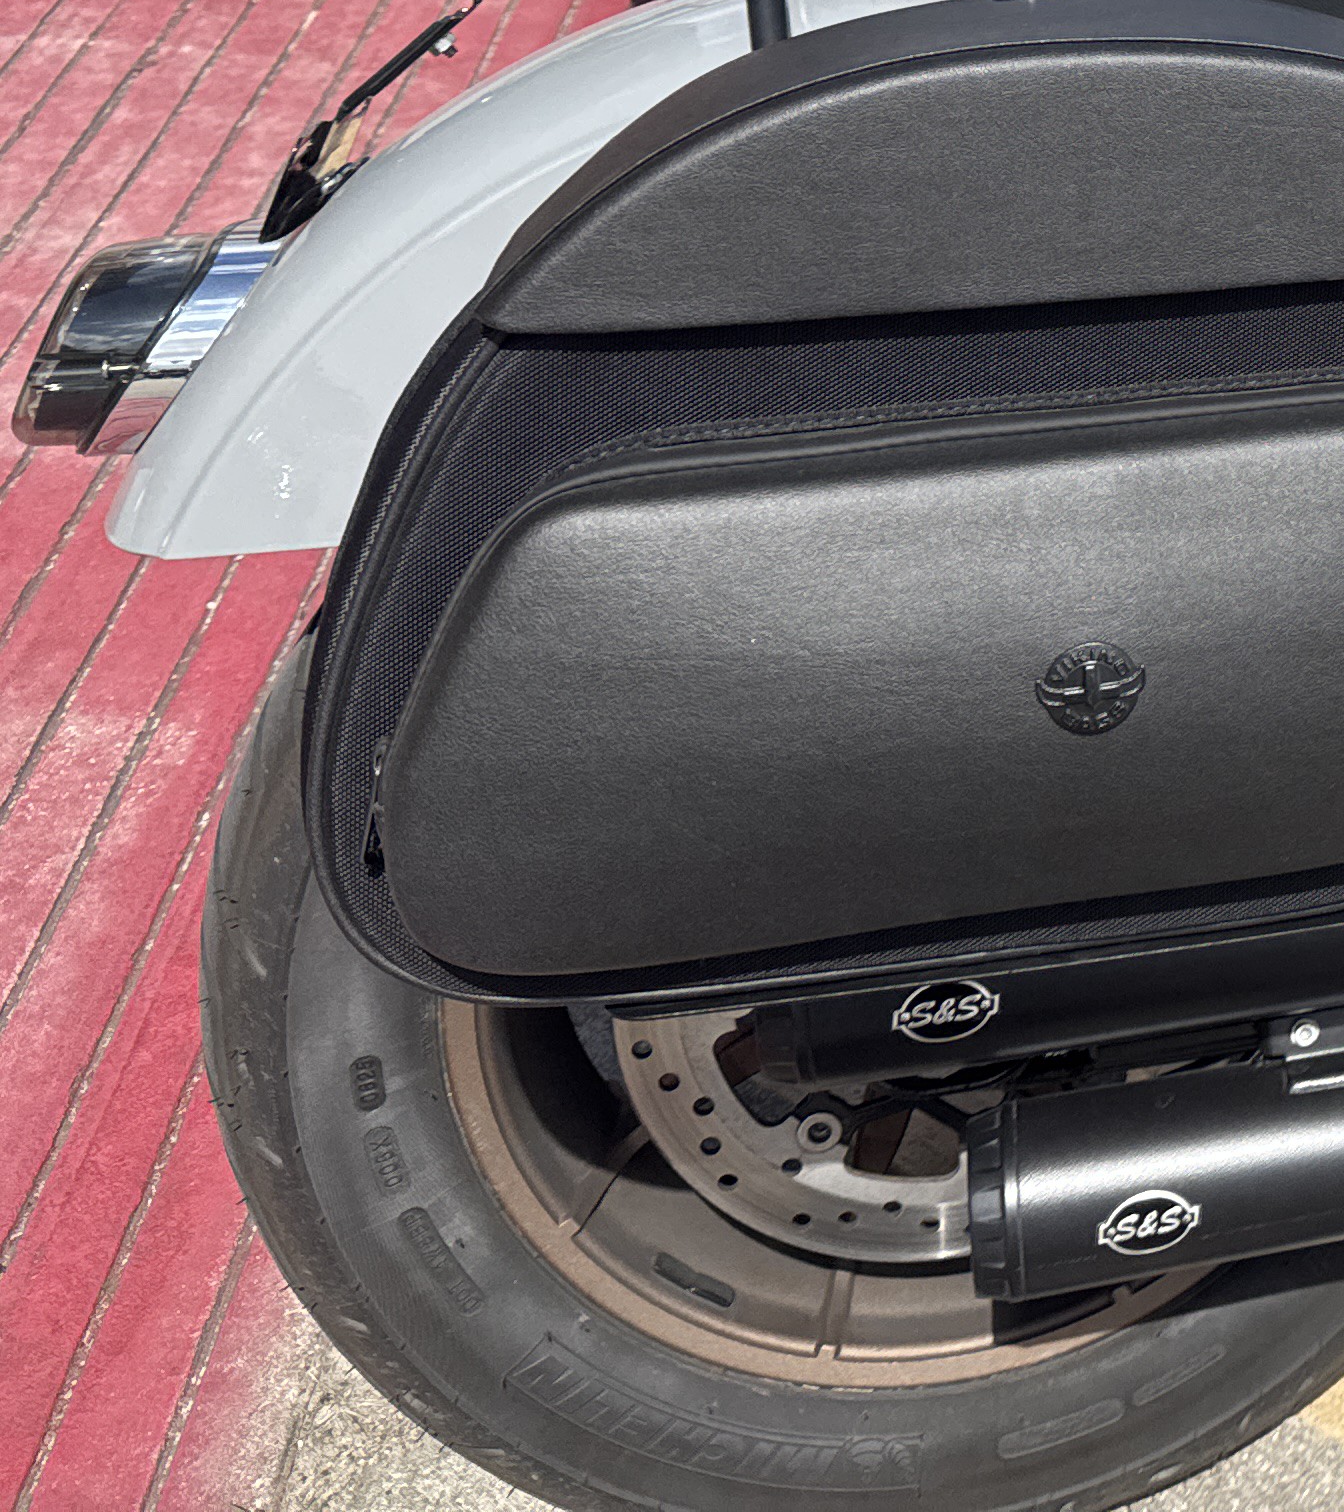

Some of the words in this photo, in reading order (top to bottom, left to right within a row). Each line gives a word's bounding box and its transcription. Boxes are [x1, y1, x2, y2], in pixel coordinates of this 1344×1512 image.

[907, 993, 983, 1029] S&S
[1112, 1204, 1184, 1243] S&S
[512, 1354, 846, 1479] MICHELIN
